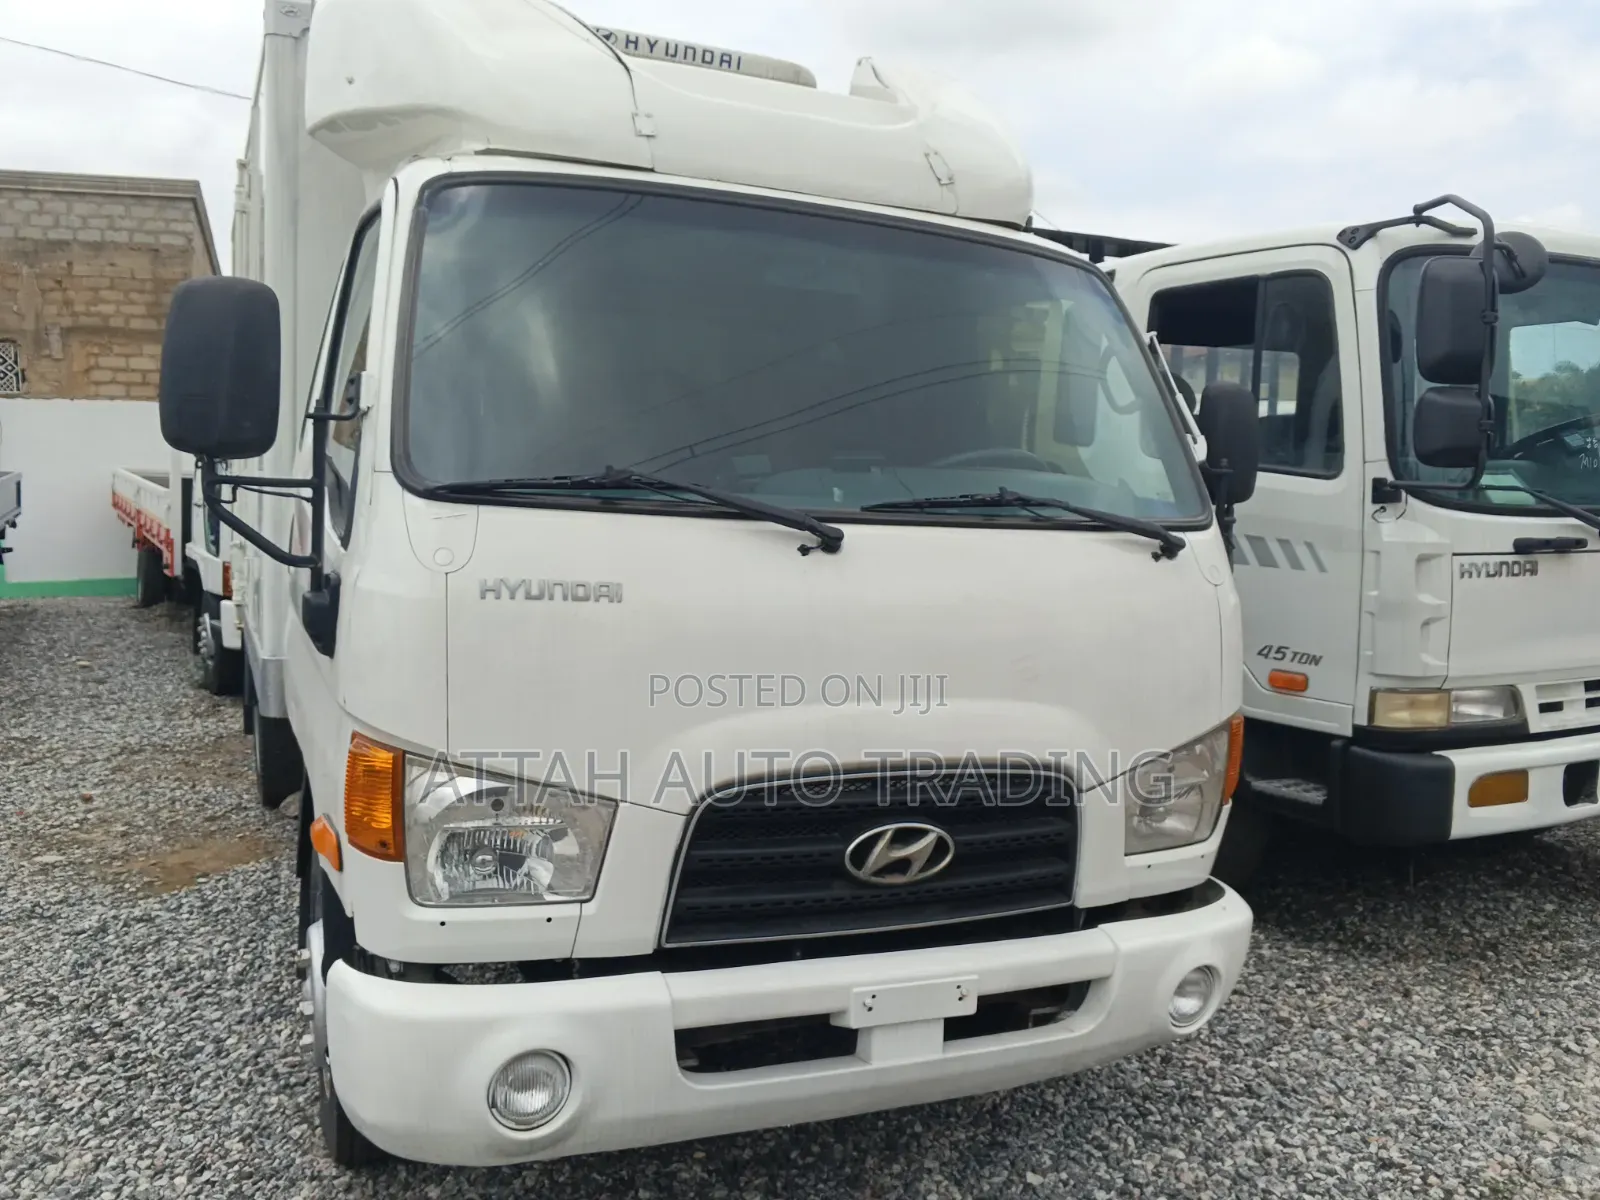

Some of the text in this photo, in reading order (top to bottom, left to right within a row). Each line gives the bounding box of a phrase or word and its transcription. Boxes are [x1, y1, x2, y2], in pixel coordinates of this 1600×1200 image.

[624, 33, 742, 71] HYUNDAI
[1459, 560, 1538, 579] HYUNDAI
[479, 578, 623, 603] HYUNDAI
[1290, 651, 1324, 667] TON
